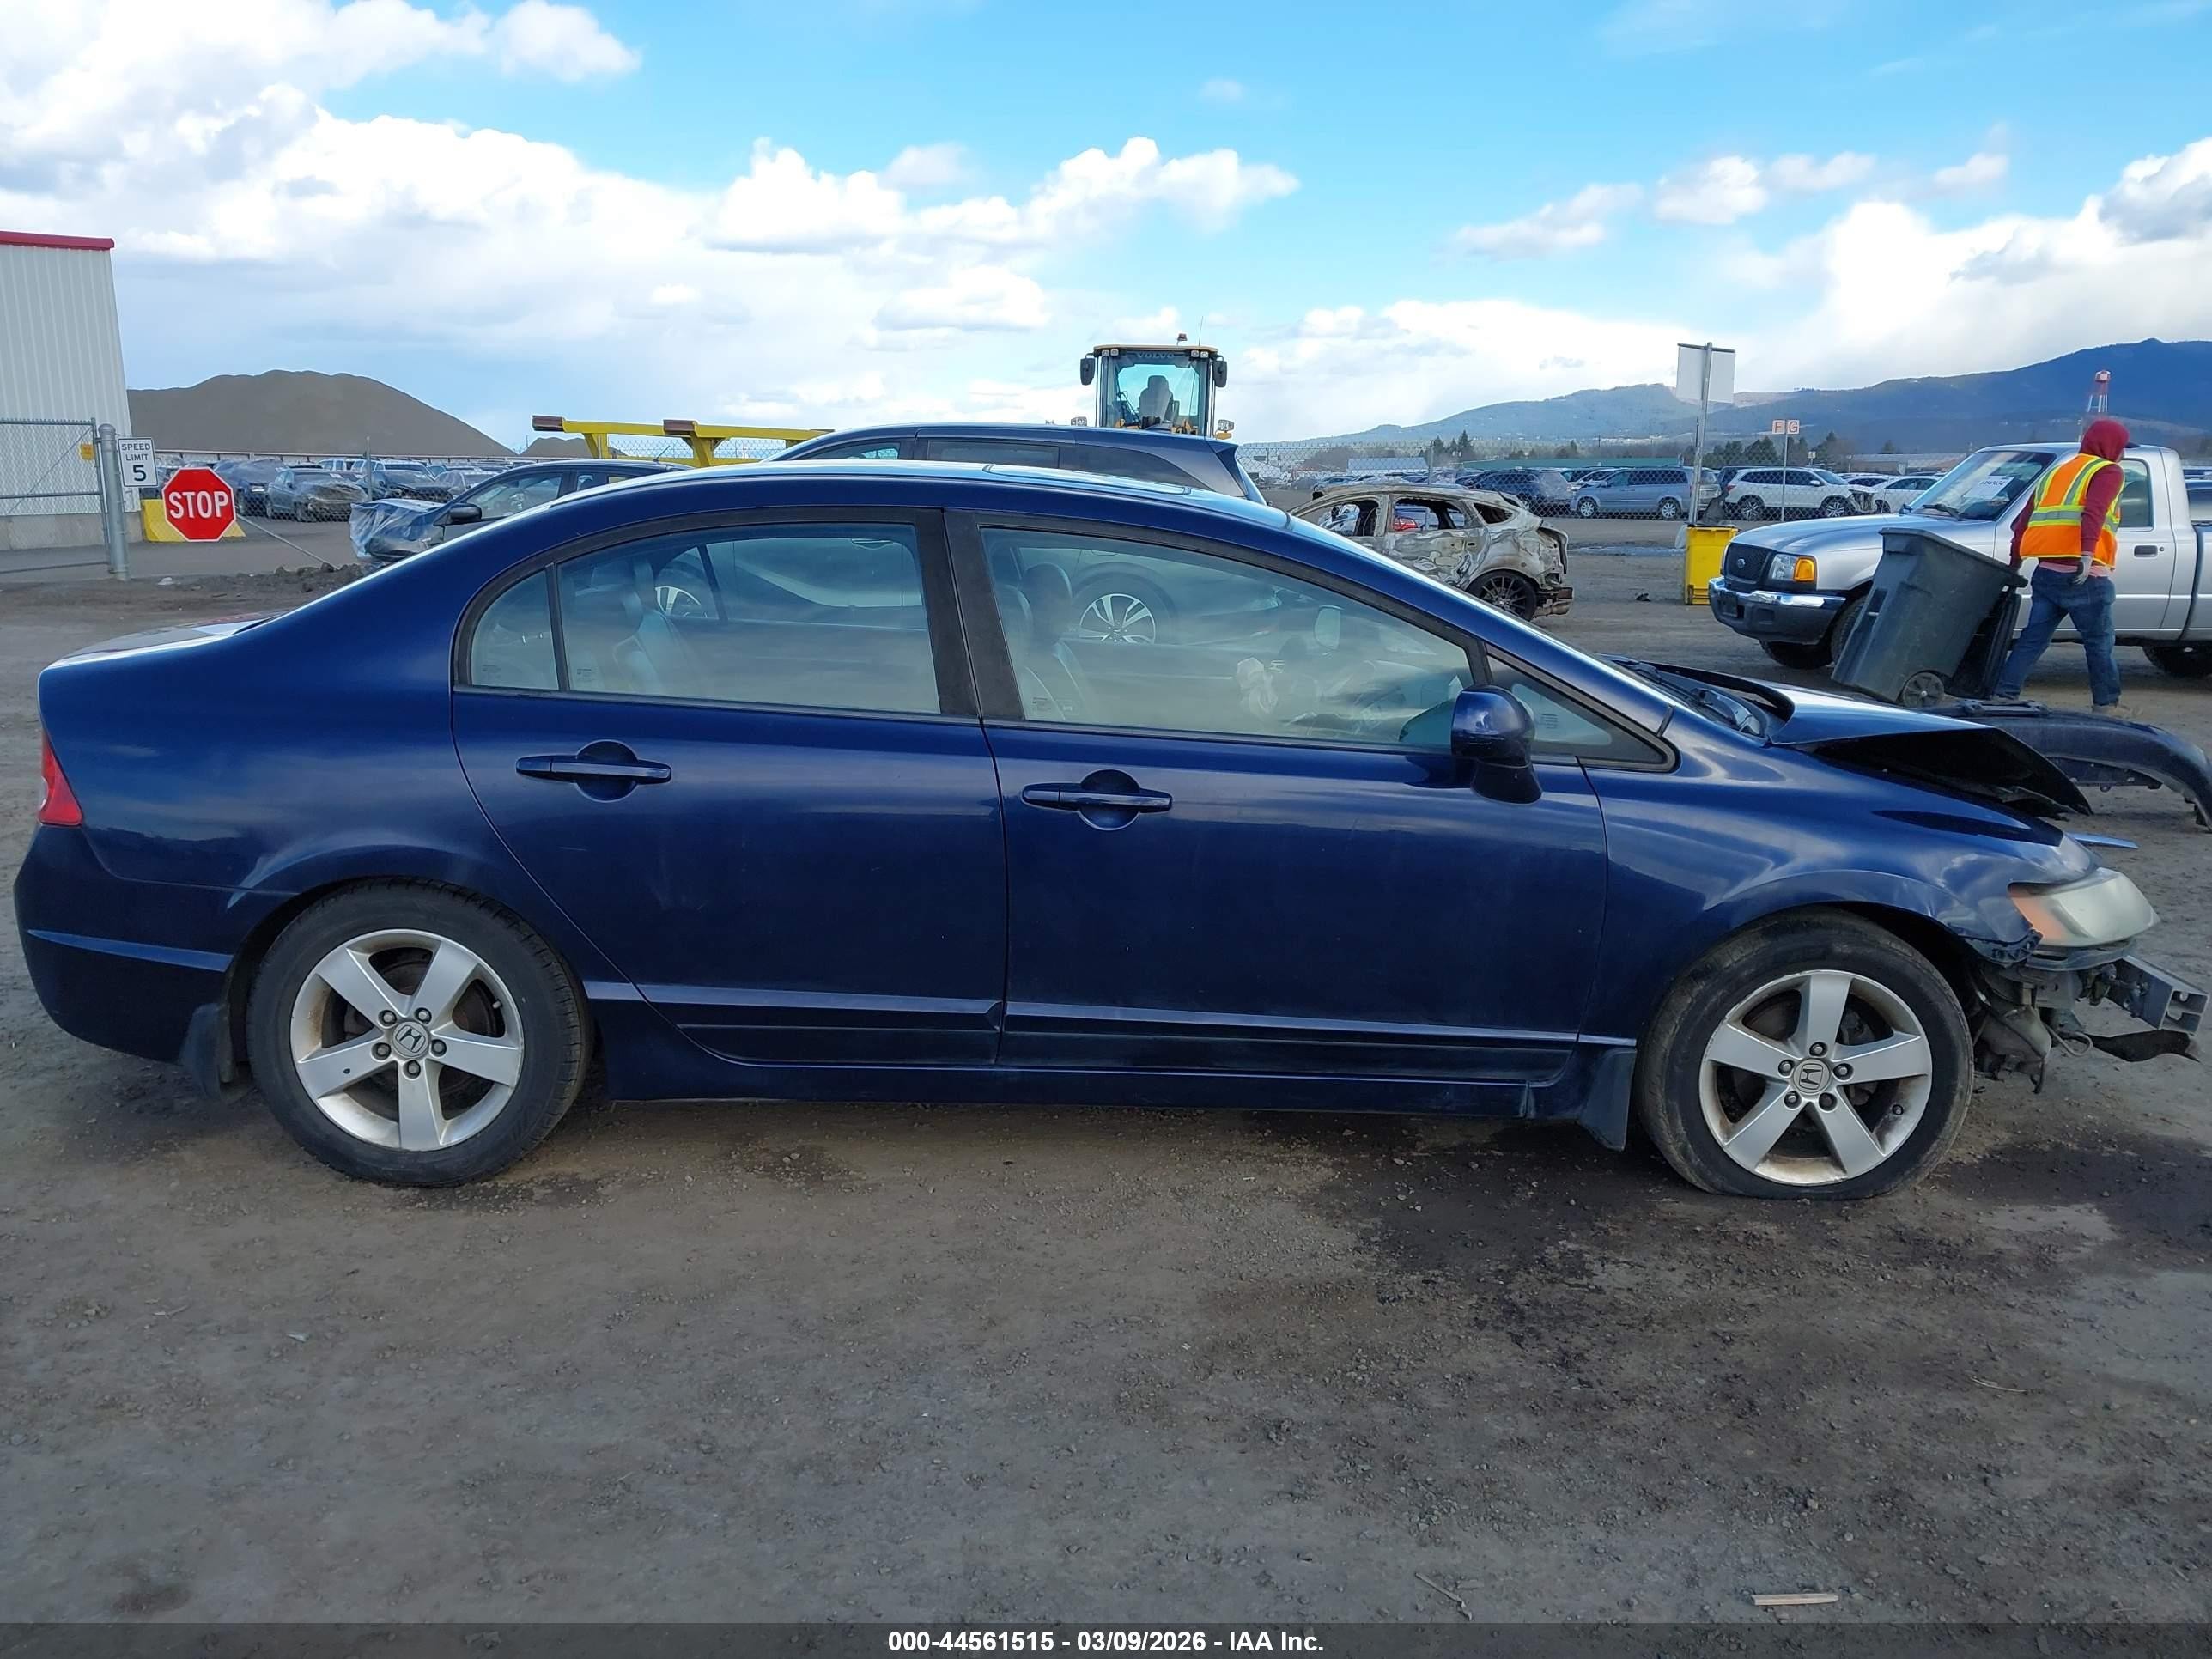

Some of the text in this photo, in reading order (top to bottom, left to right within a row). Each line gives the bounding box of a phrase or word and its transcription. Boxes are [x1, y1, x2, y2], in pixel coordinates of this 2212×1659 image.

[1774, 421, 1784, 433] F
[1789, 421, 1798, 433] G
[132, 465, 147, 482] 5
[168, 490, 229, 519] STOP
